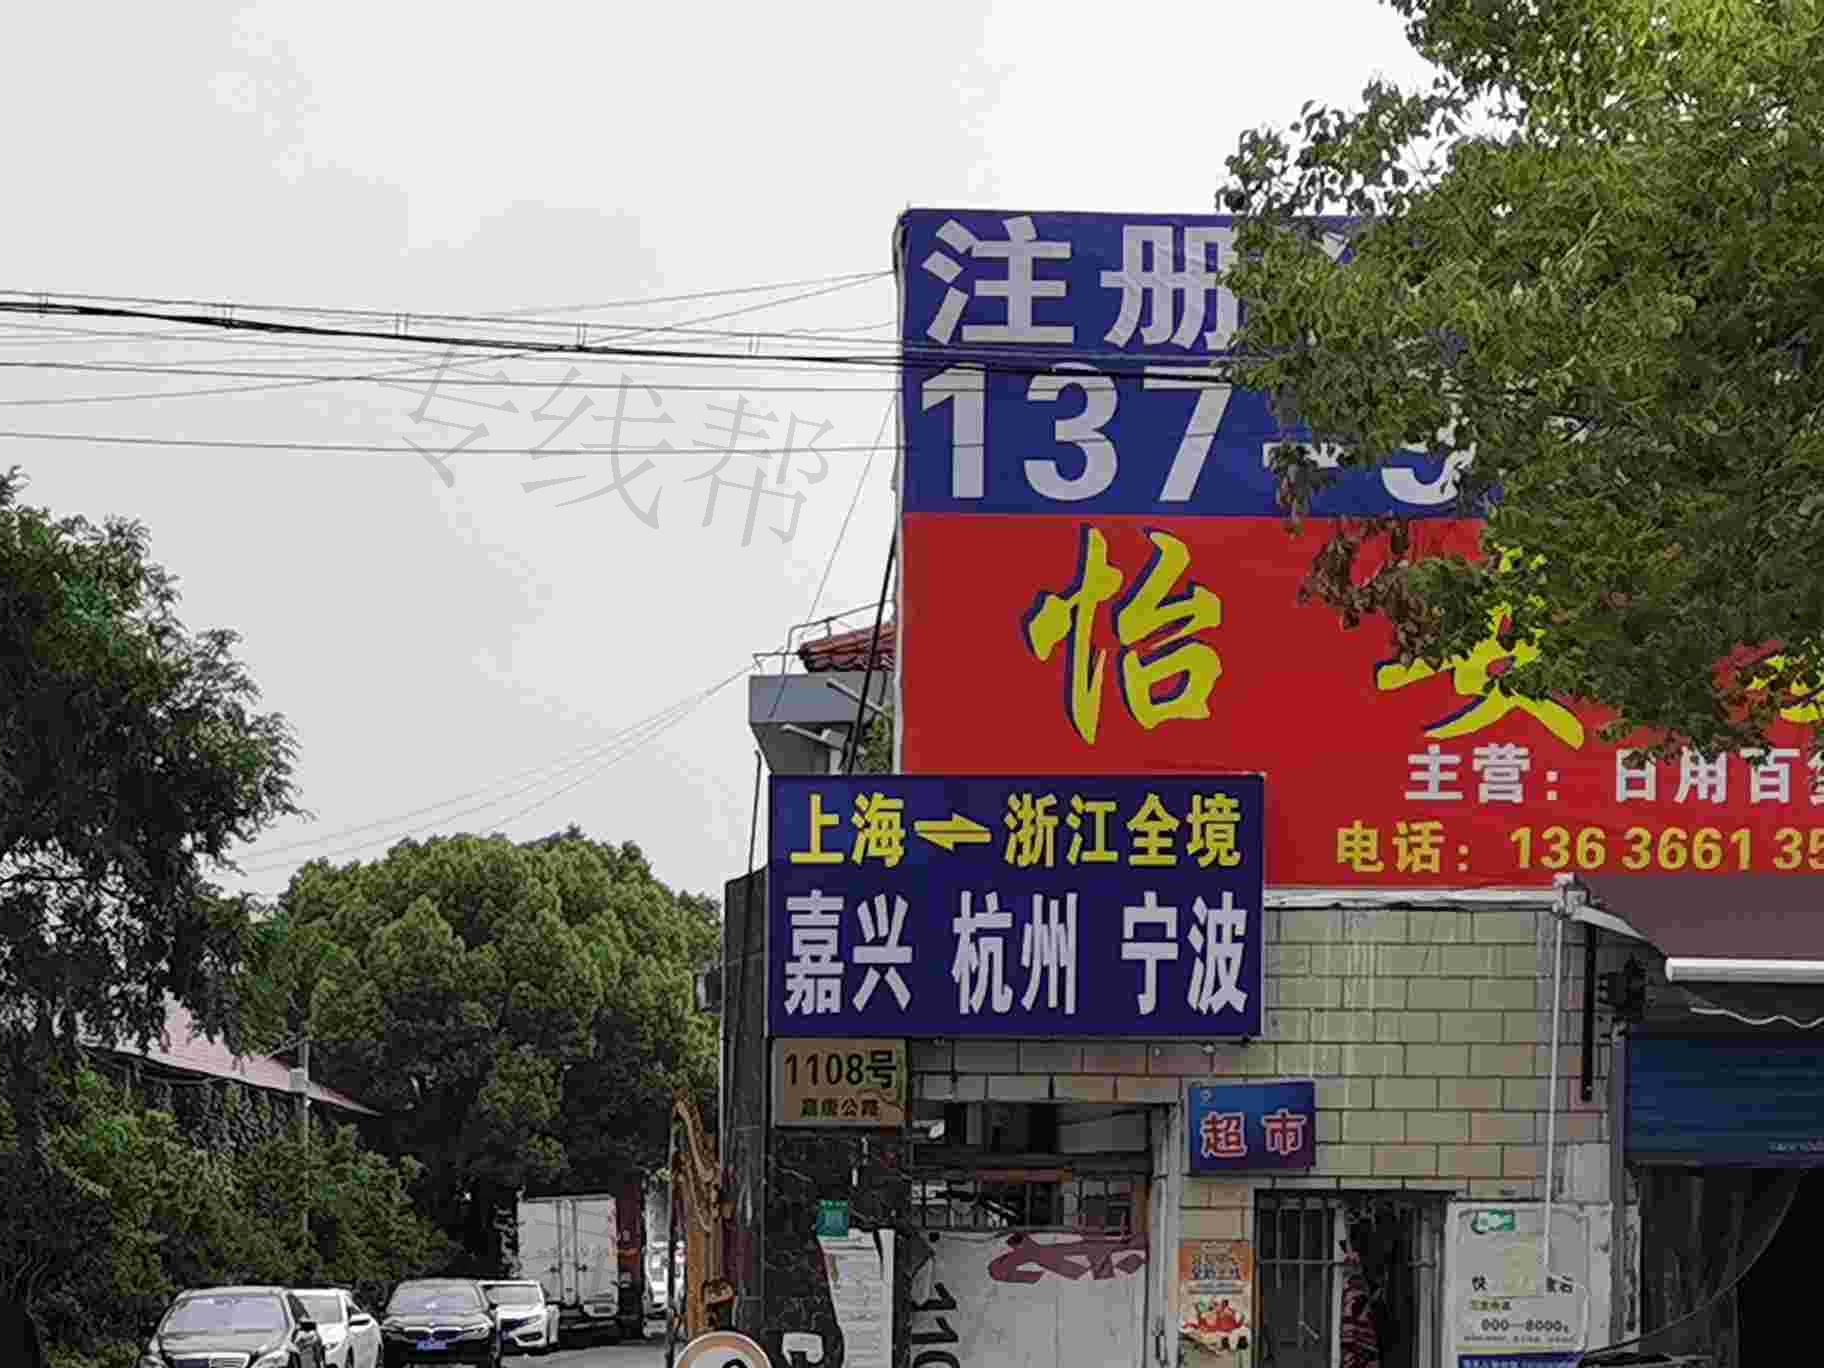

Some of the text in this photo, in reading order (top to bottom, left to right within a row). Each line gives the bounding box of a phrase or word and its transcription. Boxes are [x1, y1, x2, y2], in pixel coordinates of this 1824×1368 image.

[922, 214, 1248, 351] 注册
[1405, 743, 1560, 804] 主营：
[789, 792, 1242, 869] 上海 浙江全境
[1336, 820, 1471, 873] 电话：
[1510, 826, 1607, 871] 136
[1622, 826, 1751, 871] 3661
[783, 889, 1249, 1016] 嘉兴 杭州 宁波
[783, 1049, 897, 1089] 1108号
[1200, 1108, 1308, 1158] 超市
